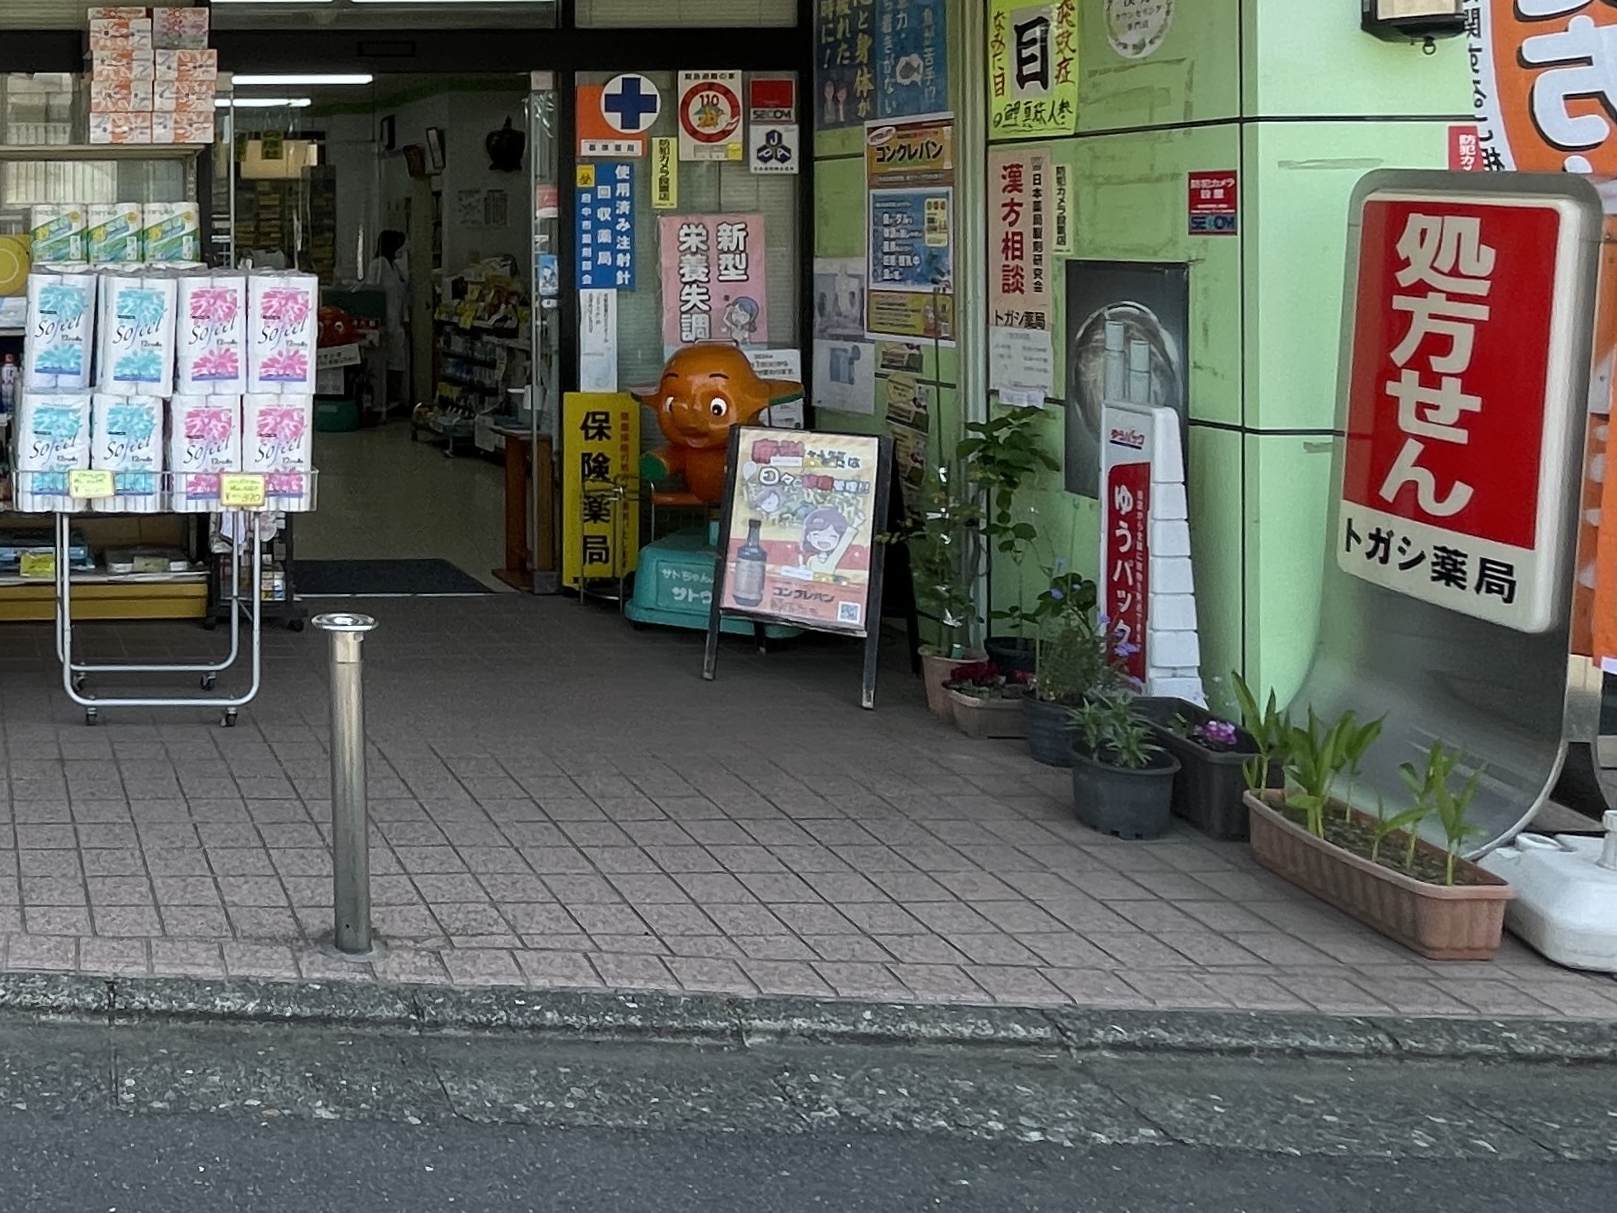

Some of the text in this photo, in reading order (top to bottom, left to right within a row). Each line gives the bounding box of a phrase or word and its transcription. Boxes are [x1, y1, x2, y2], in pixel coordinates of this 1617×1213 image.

[1013, 15, 1051, 90] 目
[753, 110, 792, 120] SECOM
[716, 222, 749, 282] 新型
[1001, 163, 1025, 295] 漢方相談
[1191, 216, 1235, 230] SECOM
[1378, 213, 1496, 517] 処方せん
[580, 410, 612, 566] 保険薬局
[1345, 517, 1518, 604] トガシ薬局
